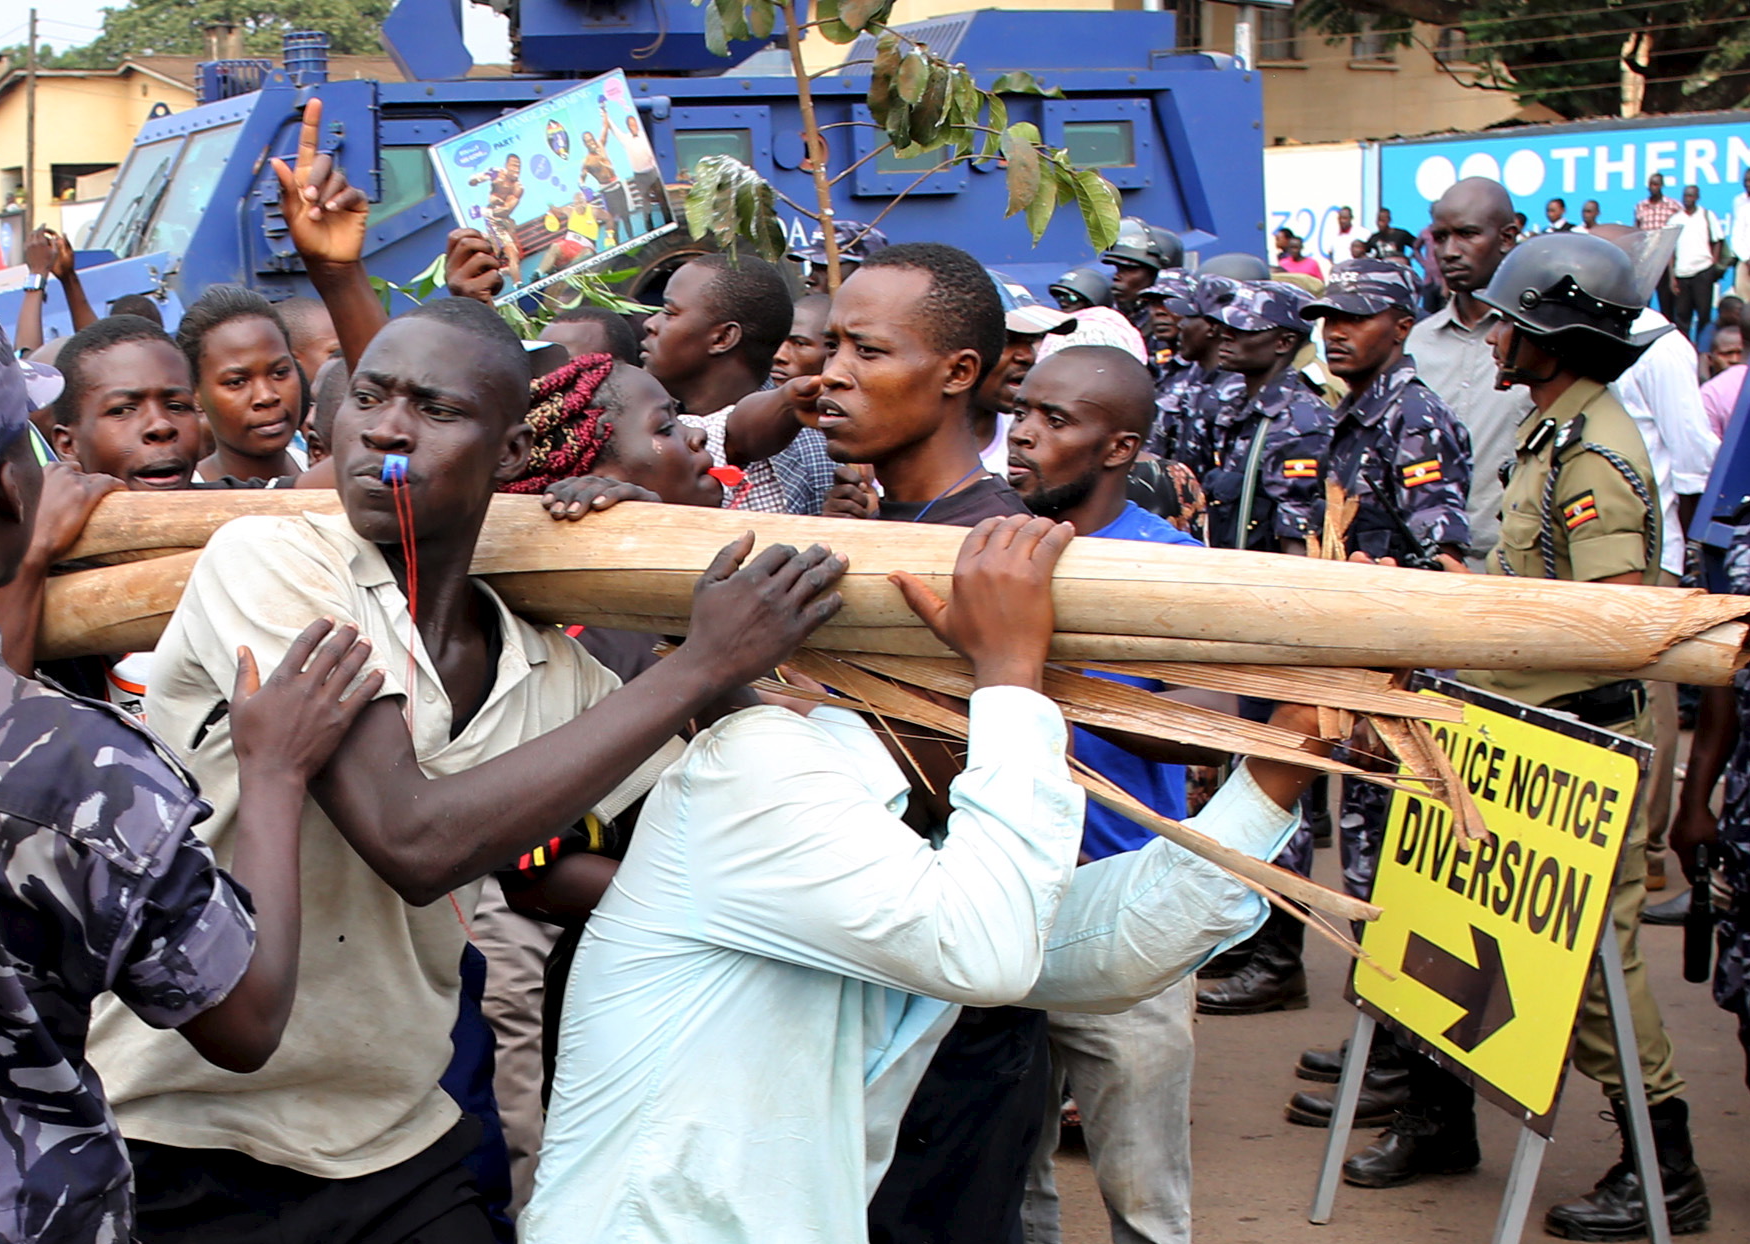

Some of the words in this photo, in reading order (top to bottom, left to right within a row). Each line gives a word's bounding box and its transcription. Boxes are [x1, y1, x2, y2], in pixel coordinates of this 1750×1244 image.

[1424, 721, 1506, 802] OLICE
[1506, 755, 1620, 848] NOTICE
[1395, 796, 1593, 952] DIVERSION
